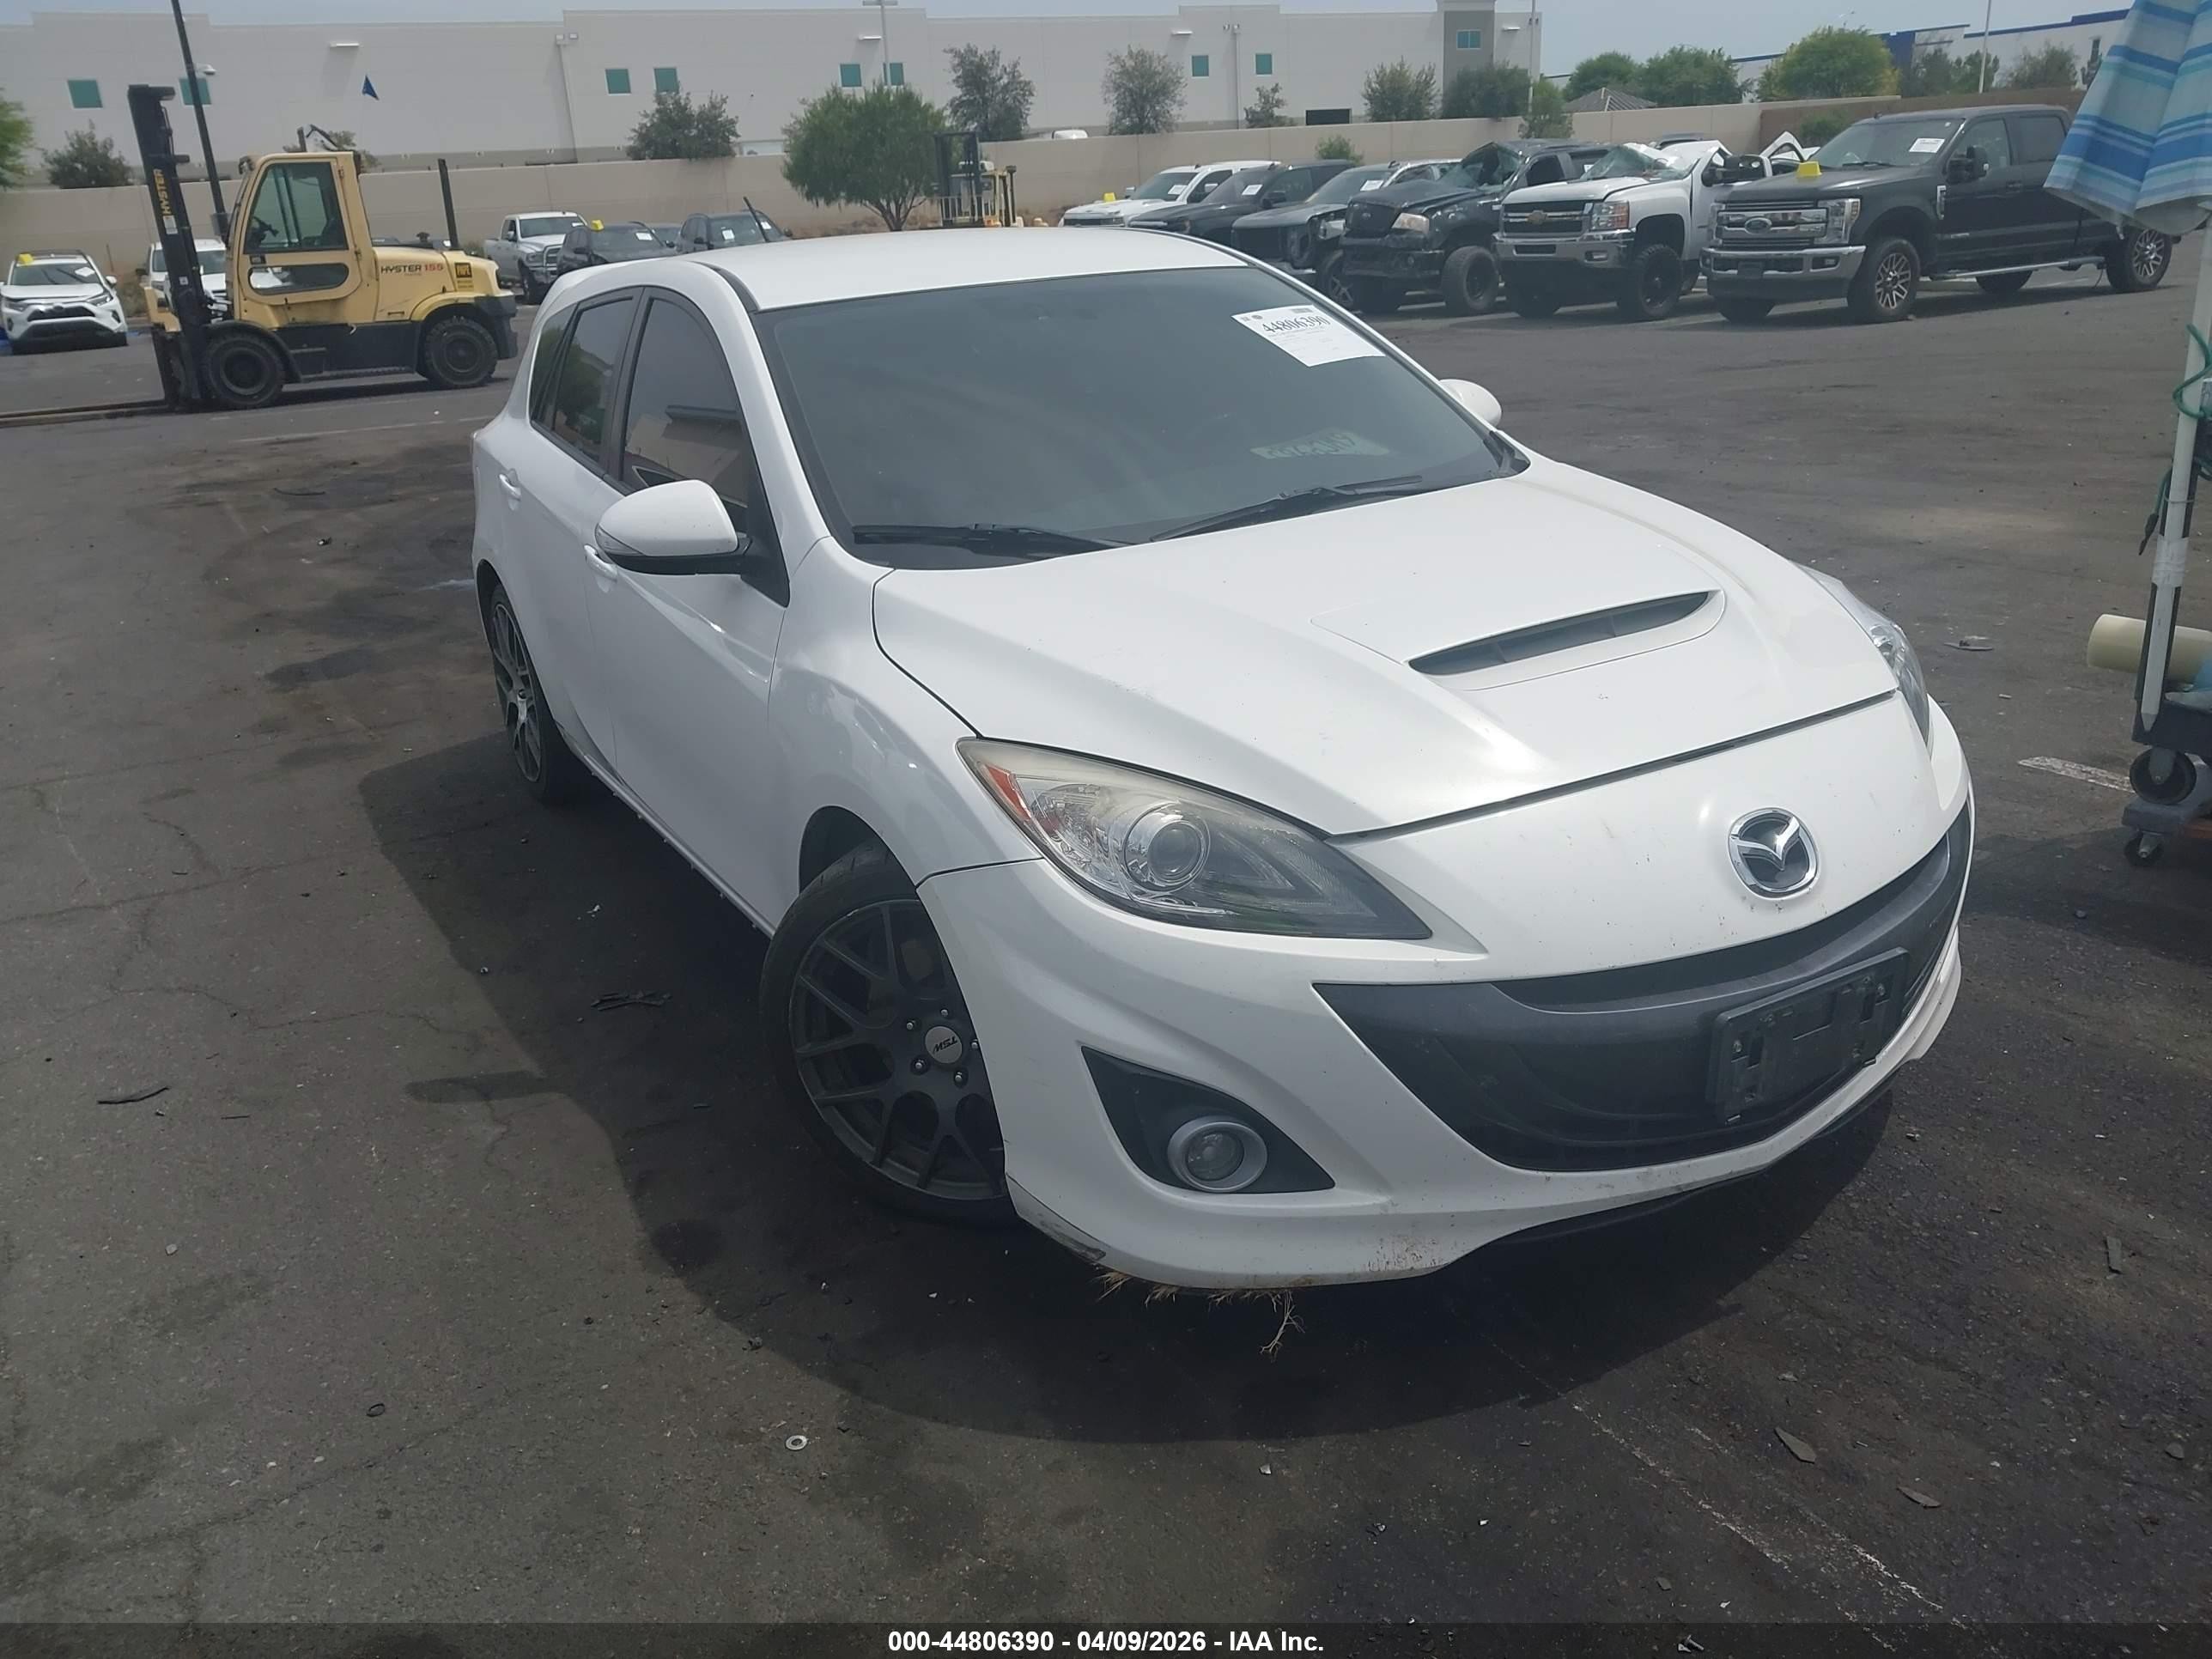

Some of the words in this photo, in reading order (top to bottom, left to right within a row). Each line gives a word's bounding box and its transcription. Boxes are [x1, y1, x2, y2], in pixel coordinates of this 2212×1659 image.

[154, 168, 172, 215] HYSTER
[380, 264, 422, 274] HYSTER
[1262, 316, 1330, 333] 44806390
[933, 1036, 958, 1054] TSW
